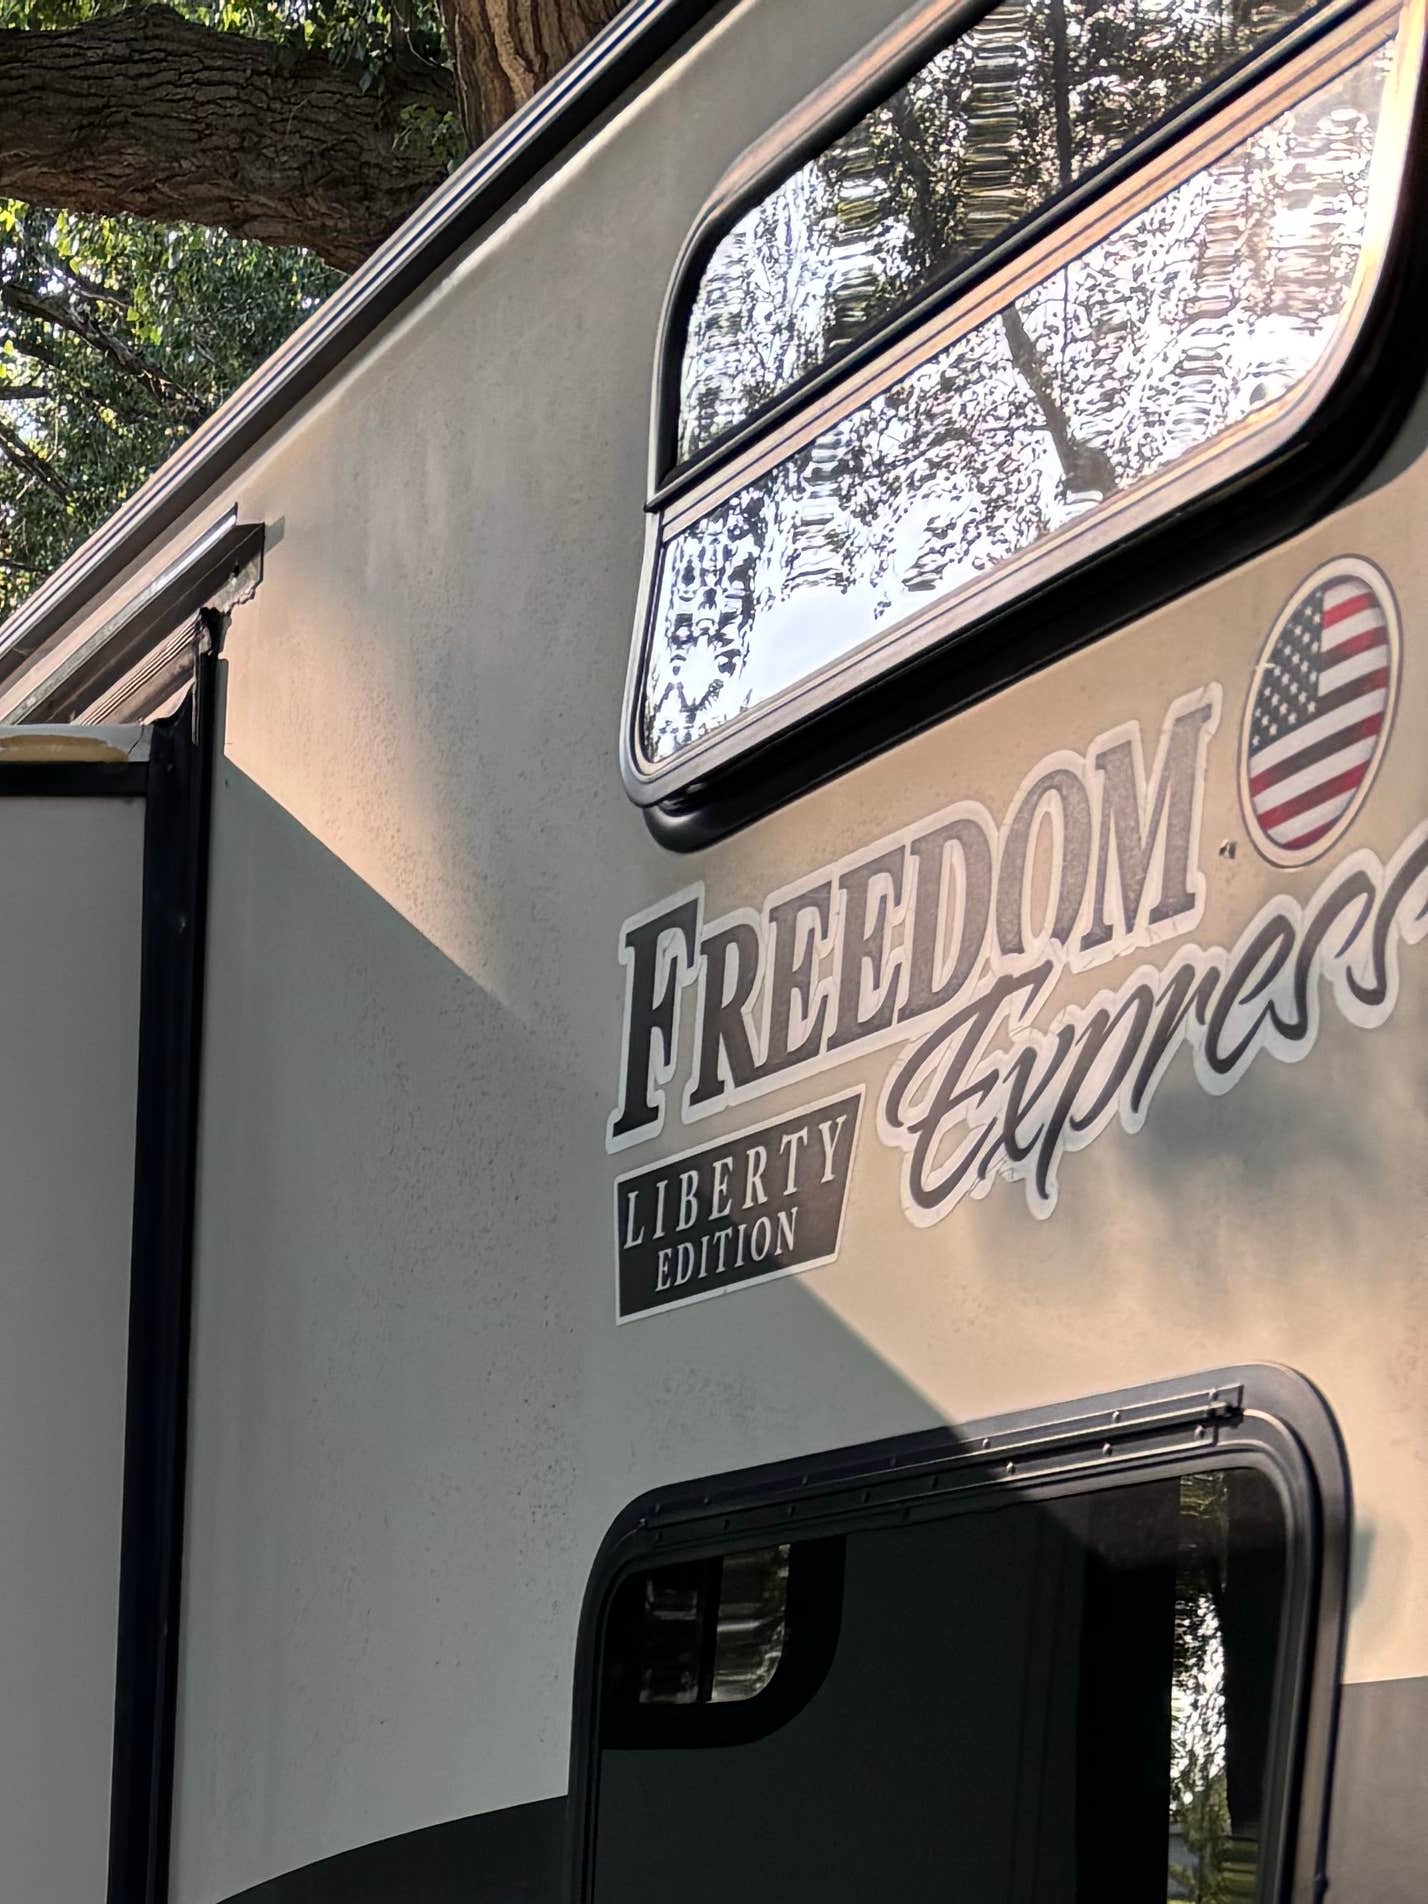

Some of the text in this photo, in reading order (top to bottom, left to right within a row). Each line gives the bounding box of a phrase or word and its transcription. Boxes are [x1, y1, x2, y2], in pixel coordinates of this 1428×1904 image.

[612, 703, 1213, 1138] FREEDOM
[623, 1114, 847, 1249] LIBERTY
[655, 1206, 799, 1292] EDITION
